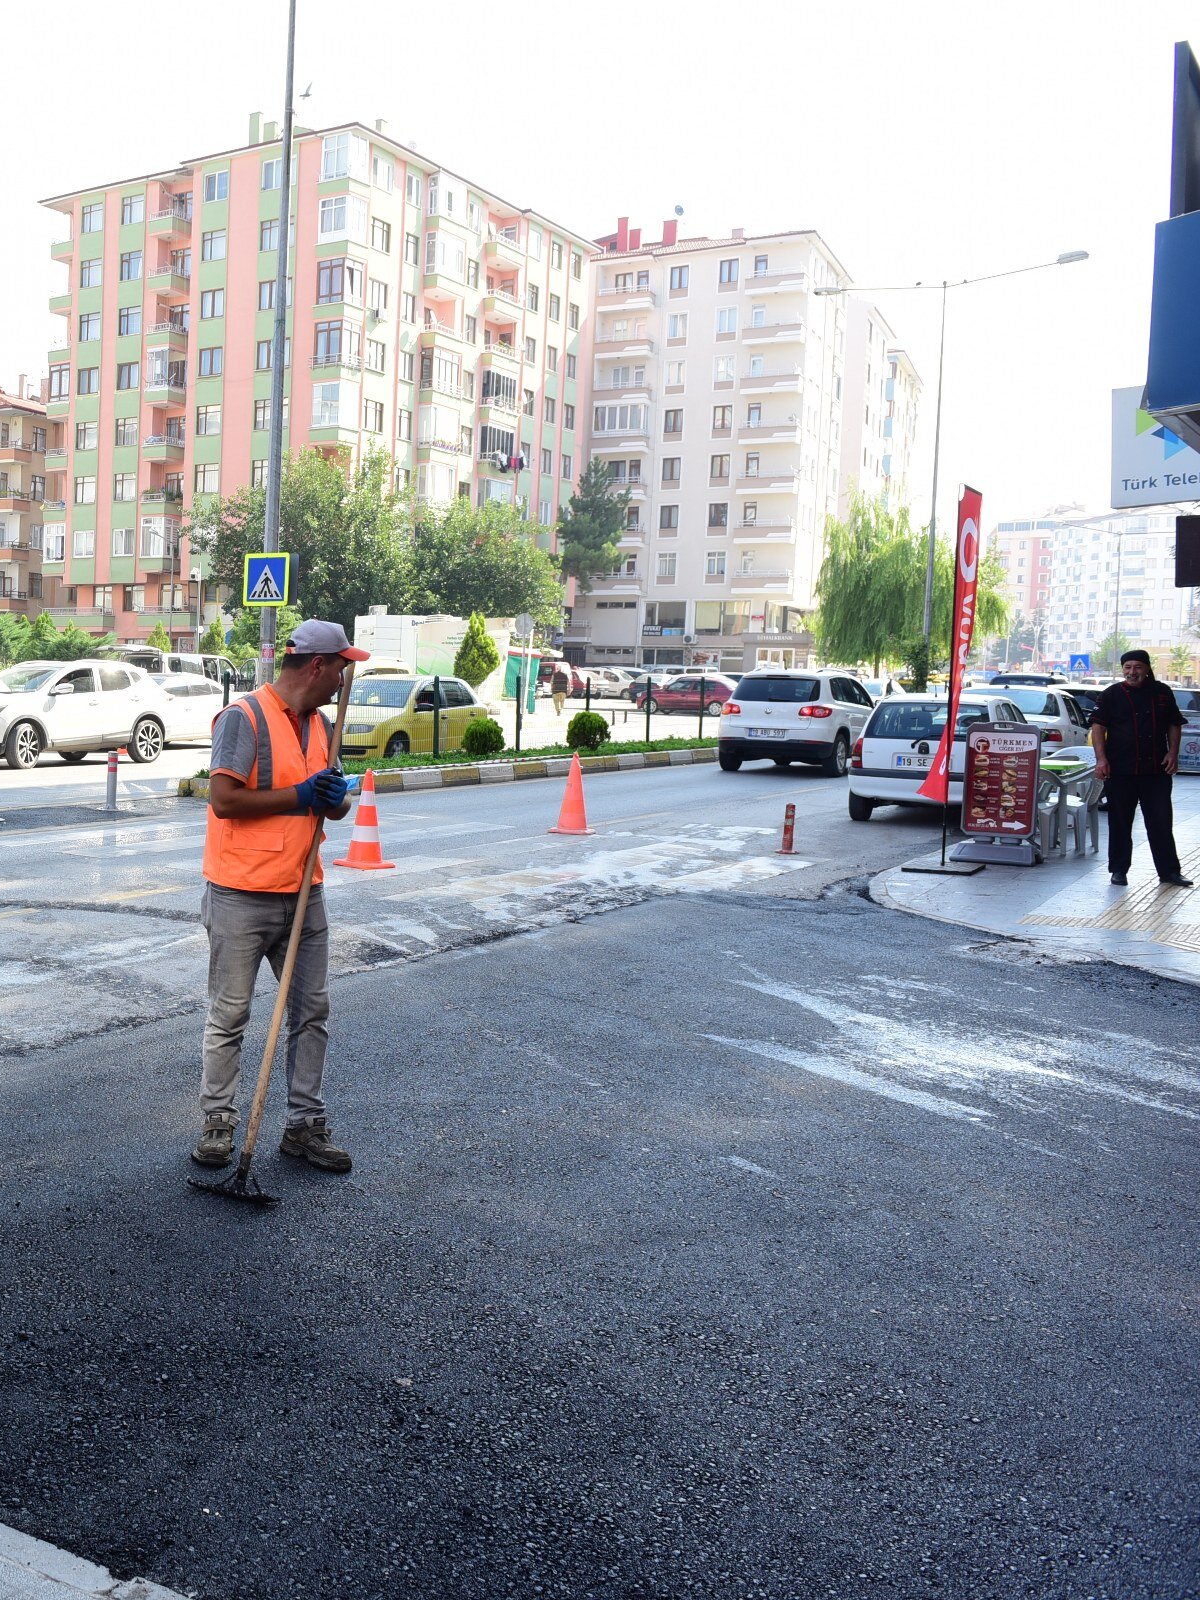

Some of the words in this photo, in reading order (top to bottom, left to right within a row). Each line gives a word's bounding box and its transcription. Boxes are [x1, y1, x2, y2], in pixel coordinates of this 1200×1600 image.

[1121, 475, 1158, 491] Türk
[1163, 473, 1200, 487] Tele
[991, 738, 1033, 747] TÜRKMEN
[902, 758, 912, 767] 19
[917, 758, 928, 767] SE
